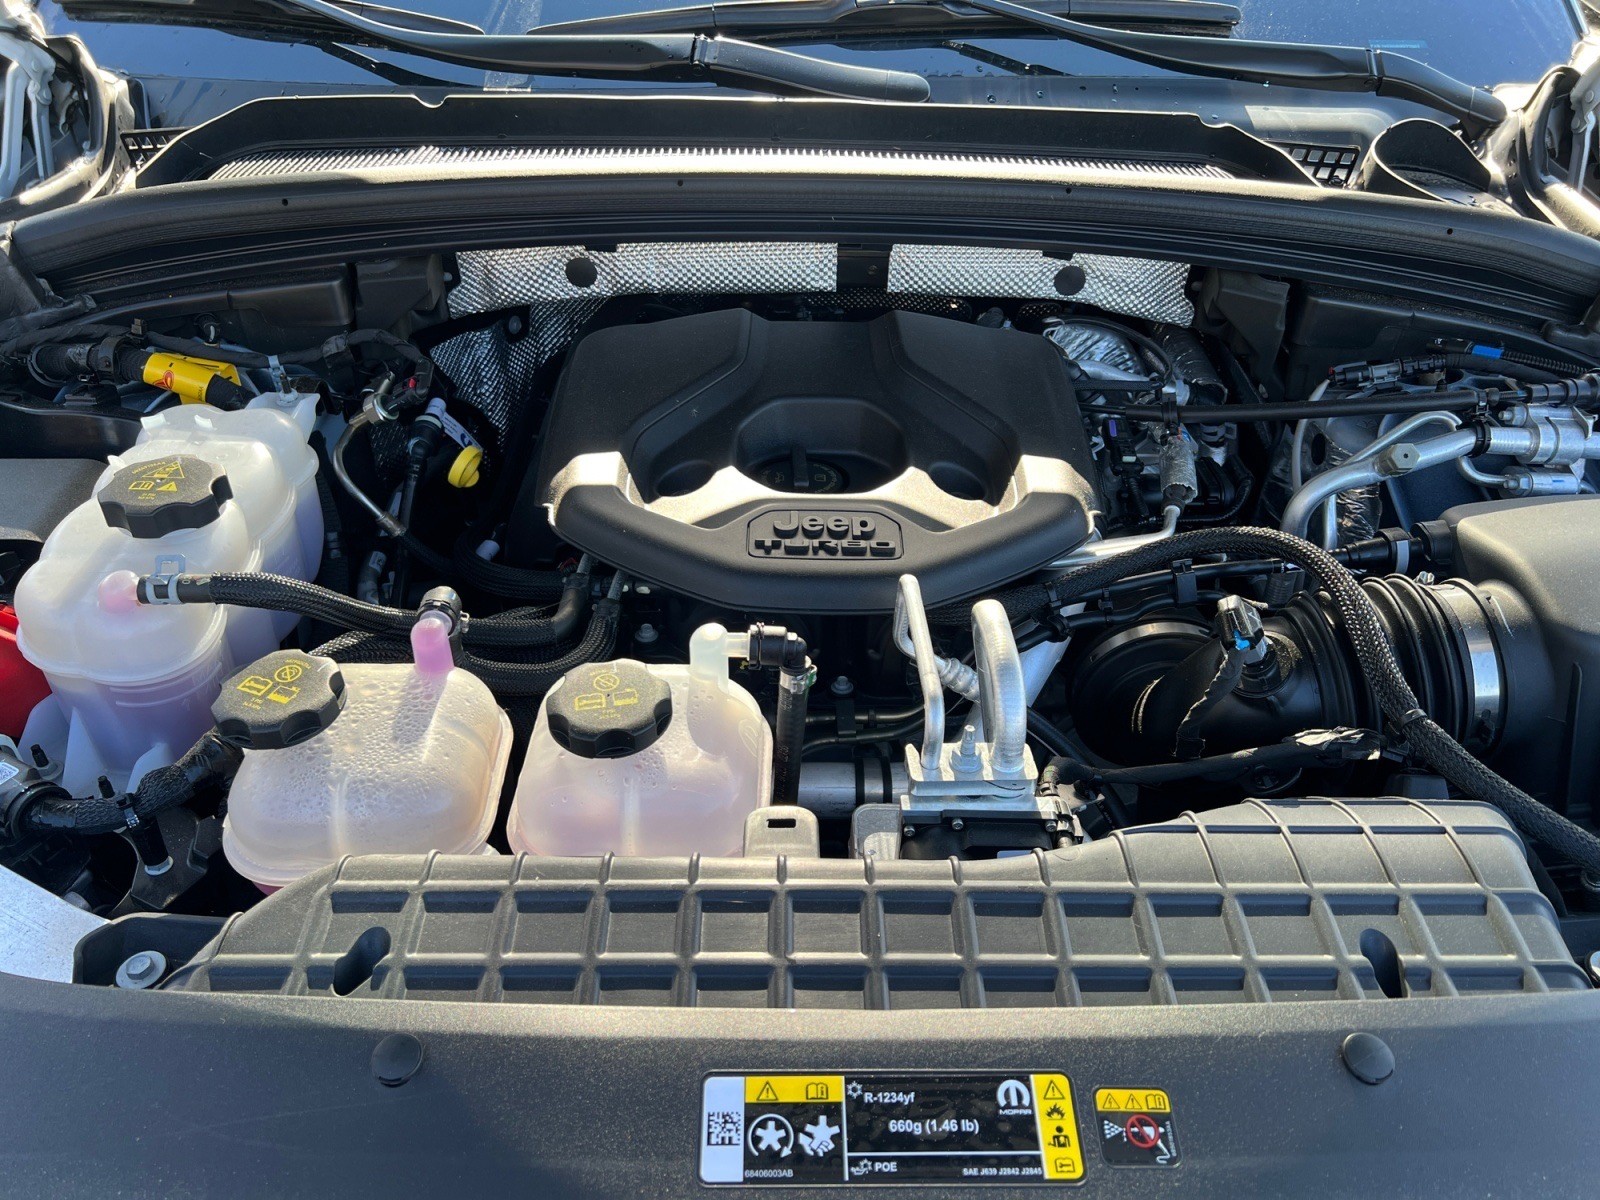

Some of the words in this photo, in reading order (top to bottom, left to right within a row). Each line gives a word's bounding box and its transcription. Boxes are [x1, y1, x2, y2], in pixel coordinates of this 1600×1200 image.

[773, 511, 876, 540] Jeep
[755, 539, 896, 556] TURBO
[864, 1092, 915, 1105] R-1234yf
[889, 1120, 922, 1134] 660g
[925, 1119, 958, 1134] (1.46
[961, 1119, 979, 1134] lb)
[744, 1169, 794, 1178] 68406003AB
[875, 1162, 898, 1172] POE
[963, 1167, 979, 1176] SAE
[980, 1167, 998, 1176] J639
[999, 1167, 1020, 1176] J2842
[1021, 1167, 1042, 1175] J2845
